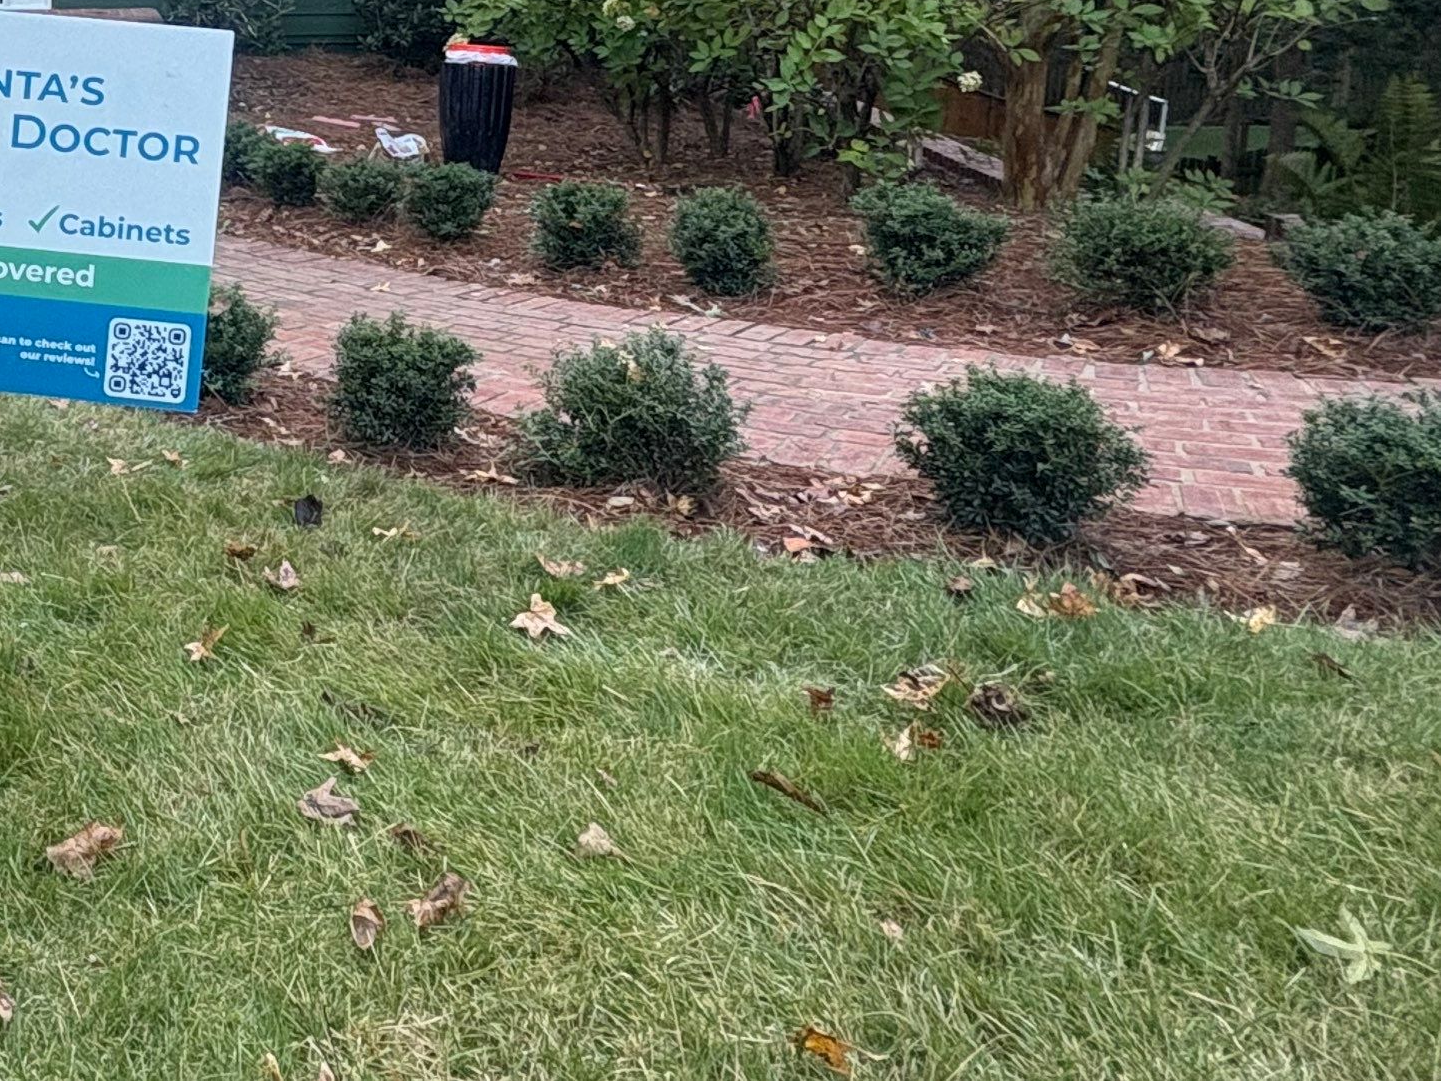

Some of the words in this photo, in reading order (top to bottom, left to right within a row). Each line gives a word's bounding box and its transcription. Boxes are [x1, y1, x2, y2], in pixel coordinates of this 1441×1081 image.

[11, 113, 200, 165] DOCTOR
[59, 213, 191, 246] Cabinets
[19, 335, 32, 347] to
[34, 337, 72, 351] check
[74, 342, 96, 353] out
[20, 350, 41, 361] our
[43, 352, 96, 367] reviews!
